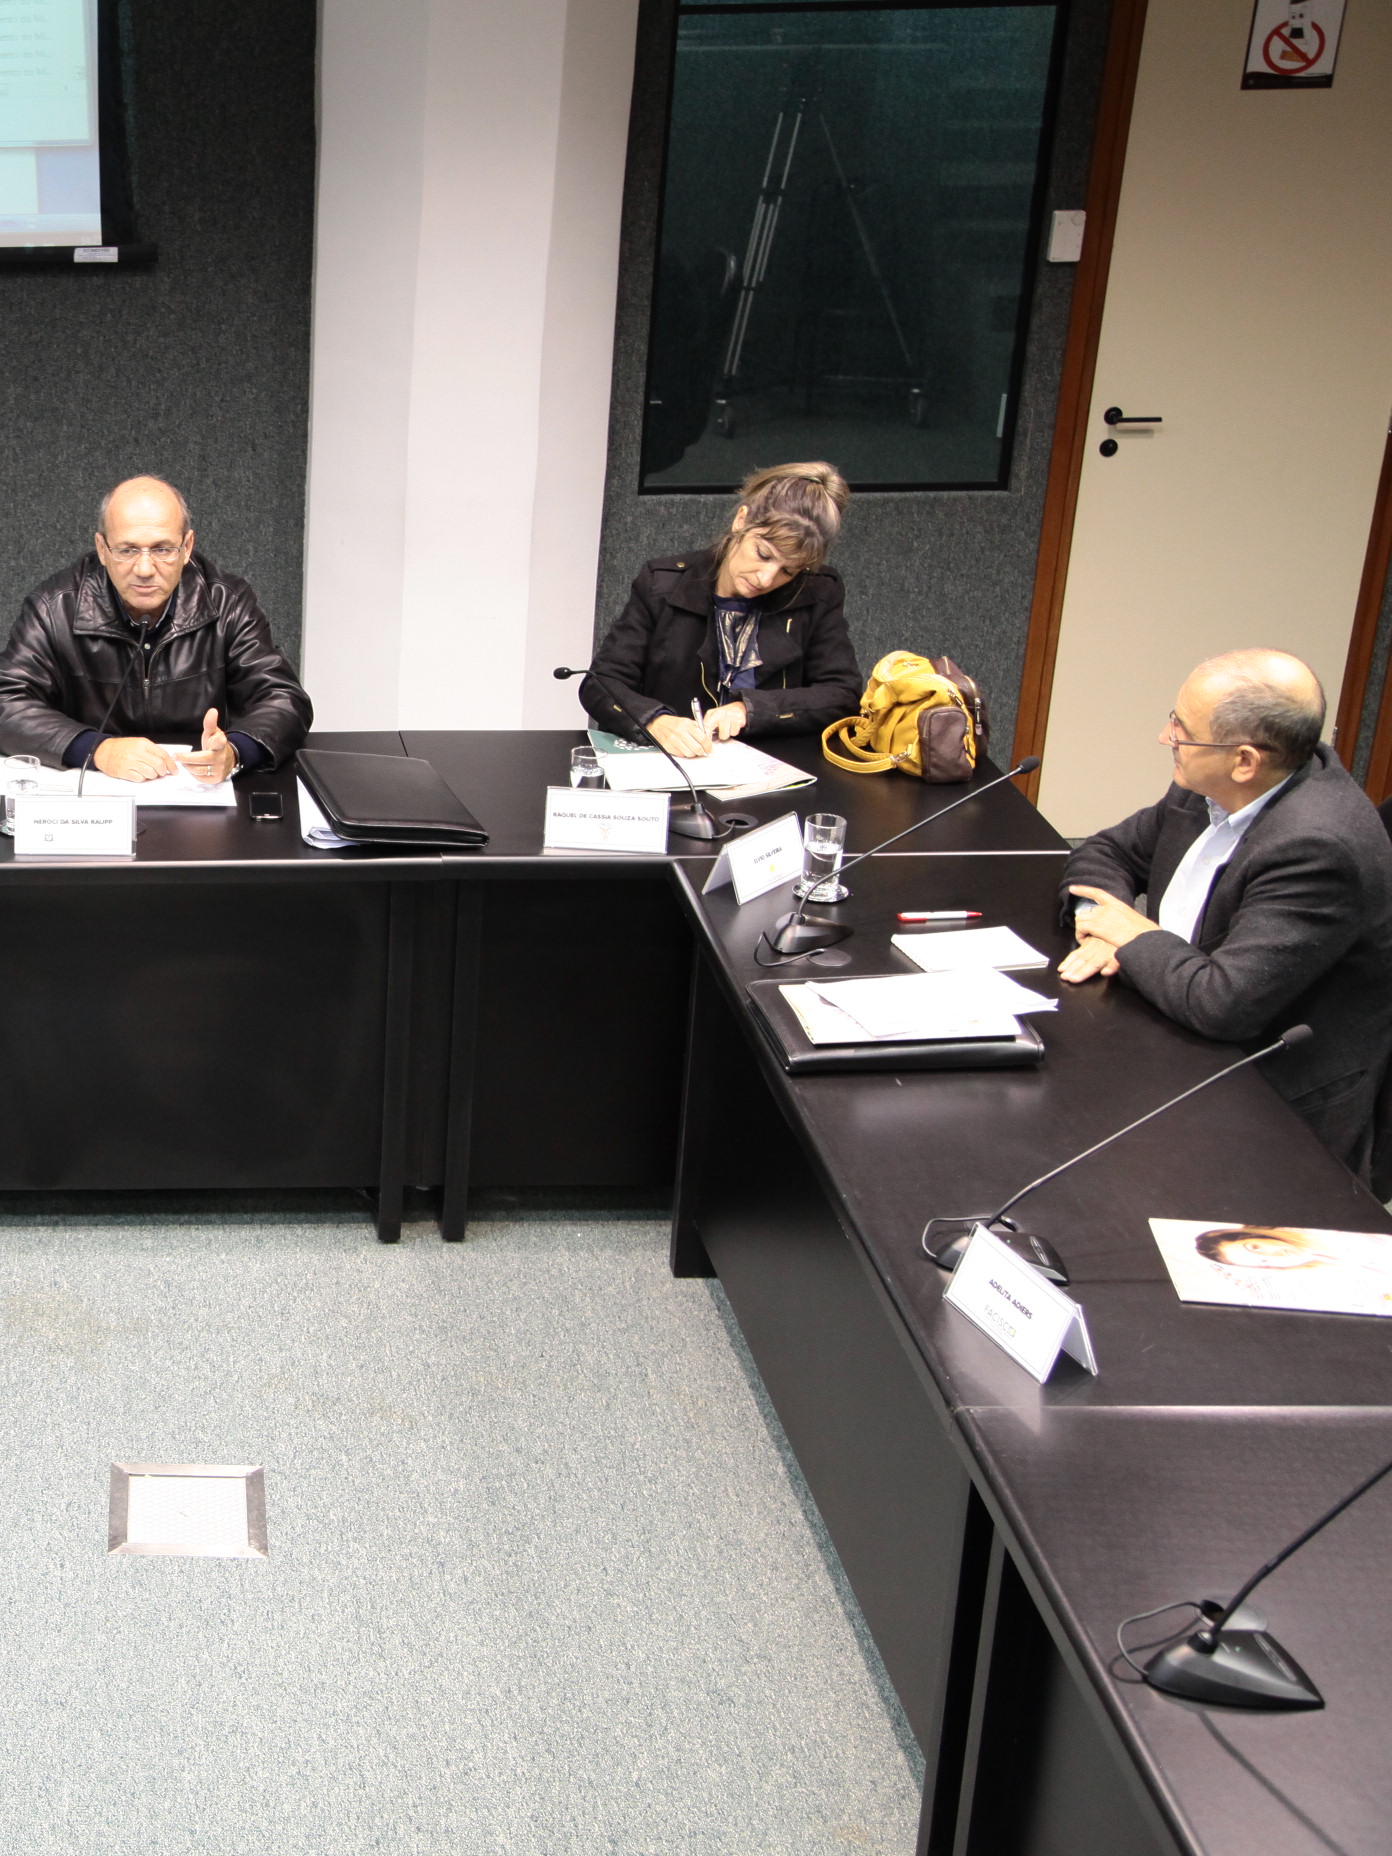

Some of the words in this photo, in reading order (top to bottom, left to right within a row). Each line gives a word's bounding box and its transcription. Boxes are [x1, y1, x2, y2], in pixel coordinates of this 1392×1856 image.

[552, 811, 577, 819] RAQUEL
[612, 814, 635, 822] SOUZA
[636, 815, 660, 823] SOUTO
[989, 1279, 1012, 1301] ADELITA
